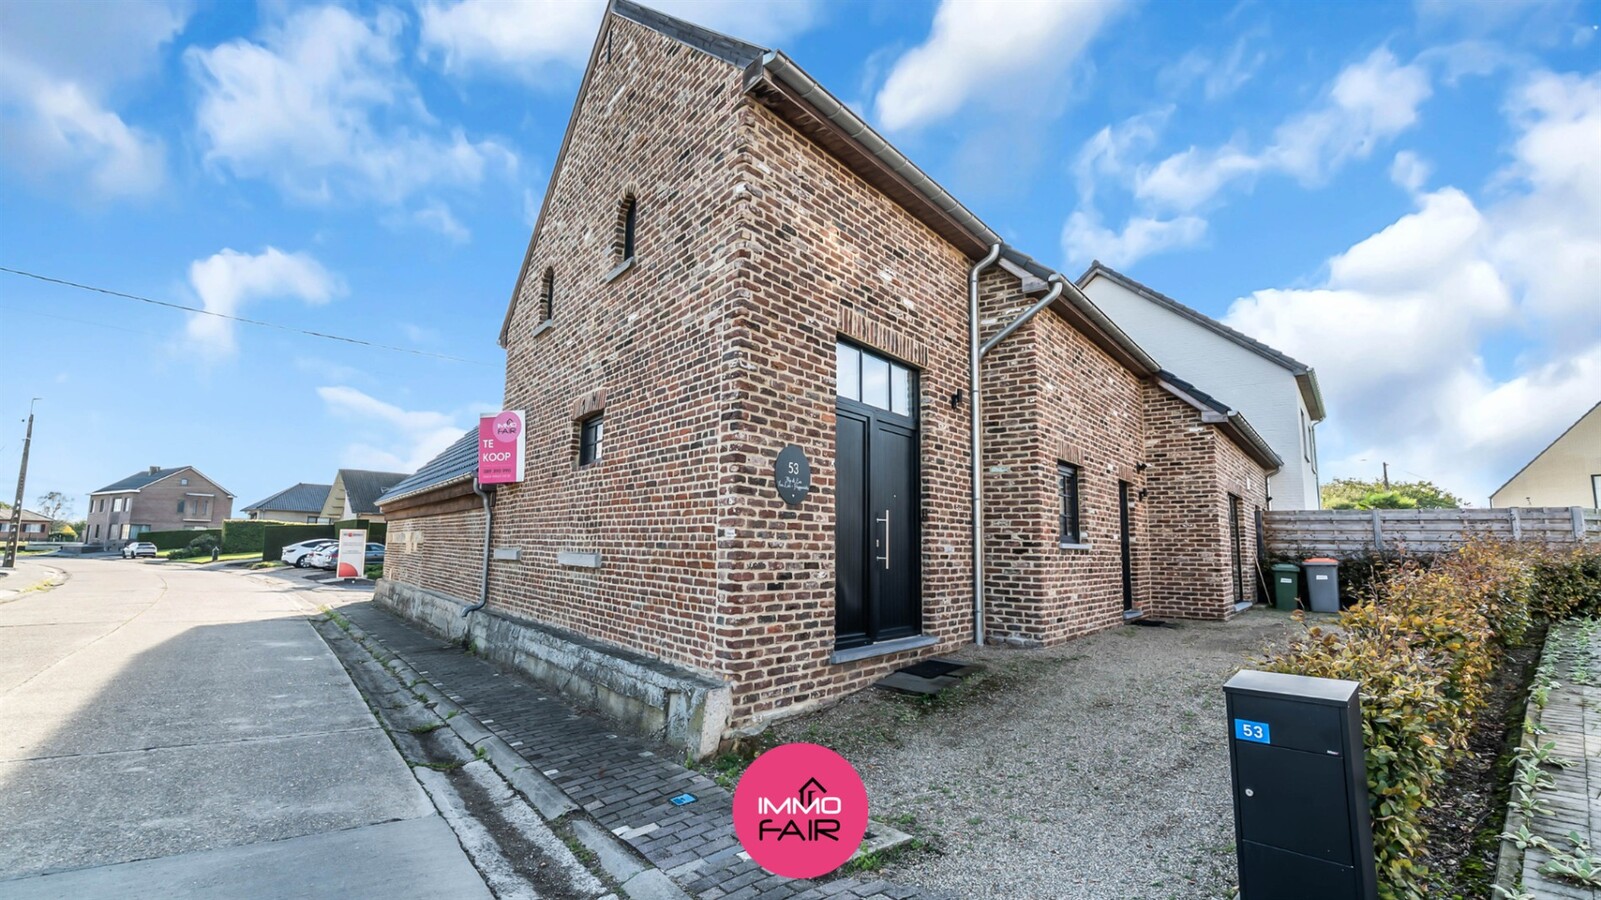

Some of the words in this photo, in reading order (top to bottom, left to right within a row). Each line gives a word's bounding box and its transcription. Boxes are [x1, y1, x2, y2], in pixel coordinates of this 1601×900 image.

[483, 439, 494, 448] TE
[482, 452, 511, 462] KOOP
[788, 462, 799, 475] 53
[1243, 724, 1264, 739] 53
